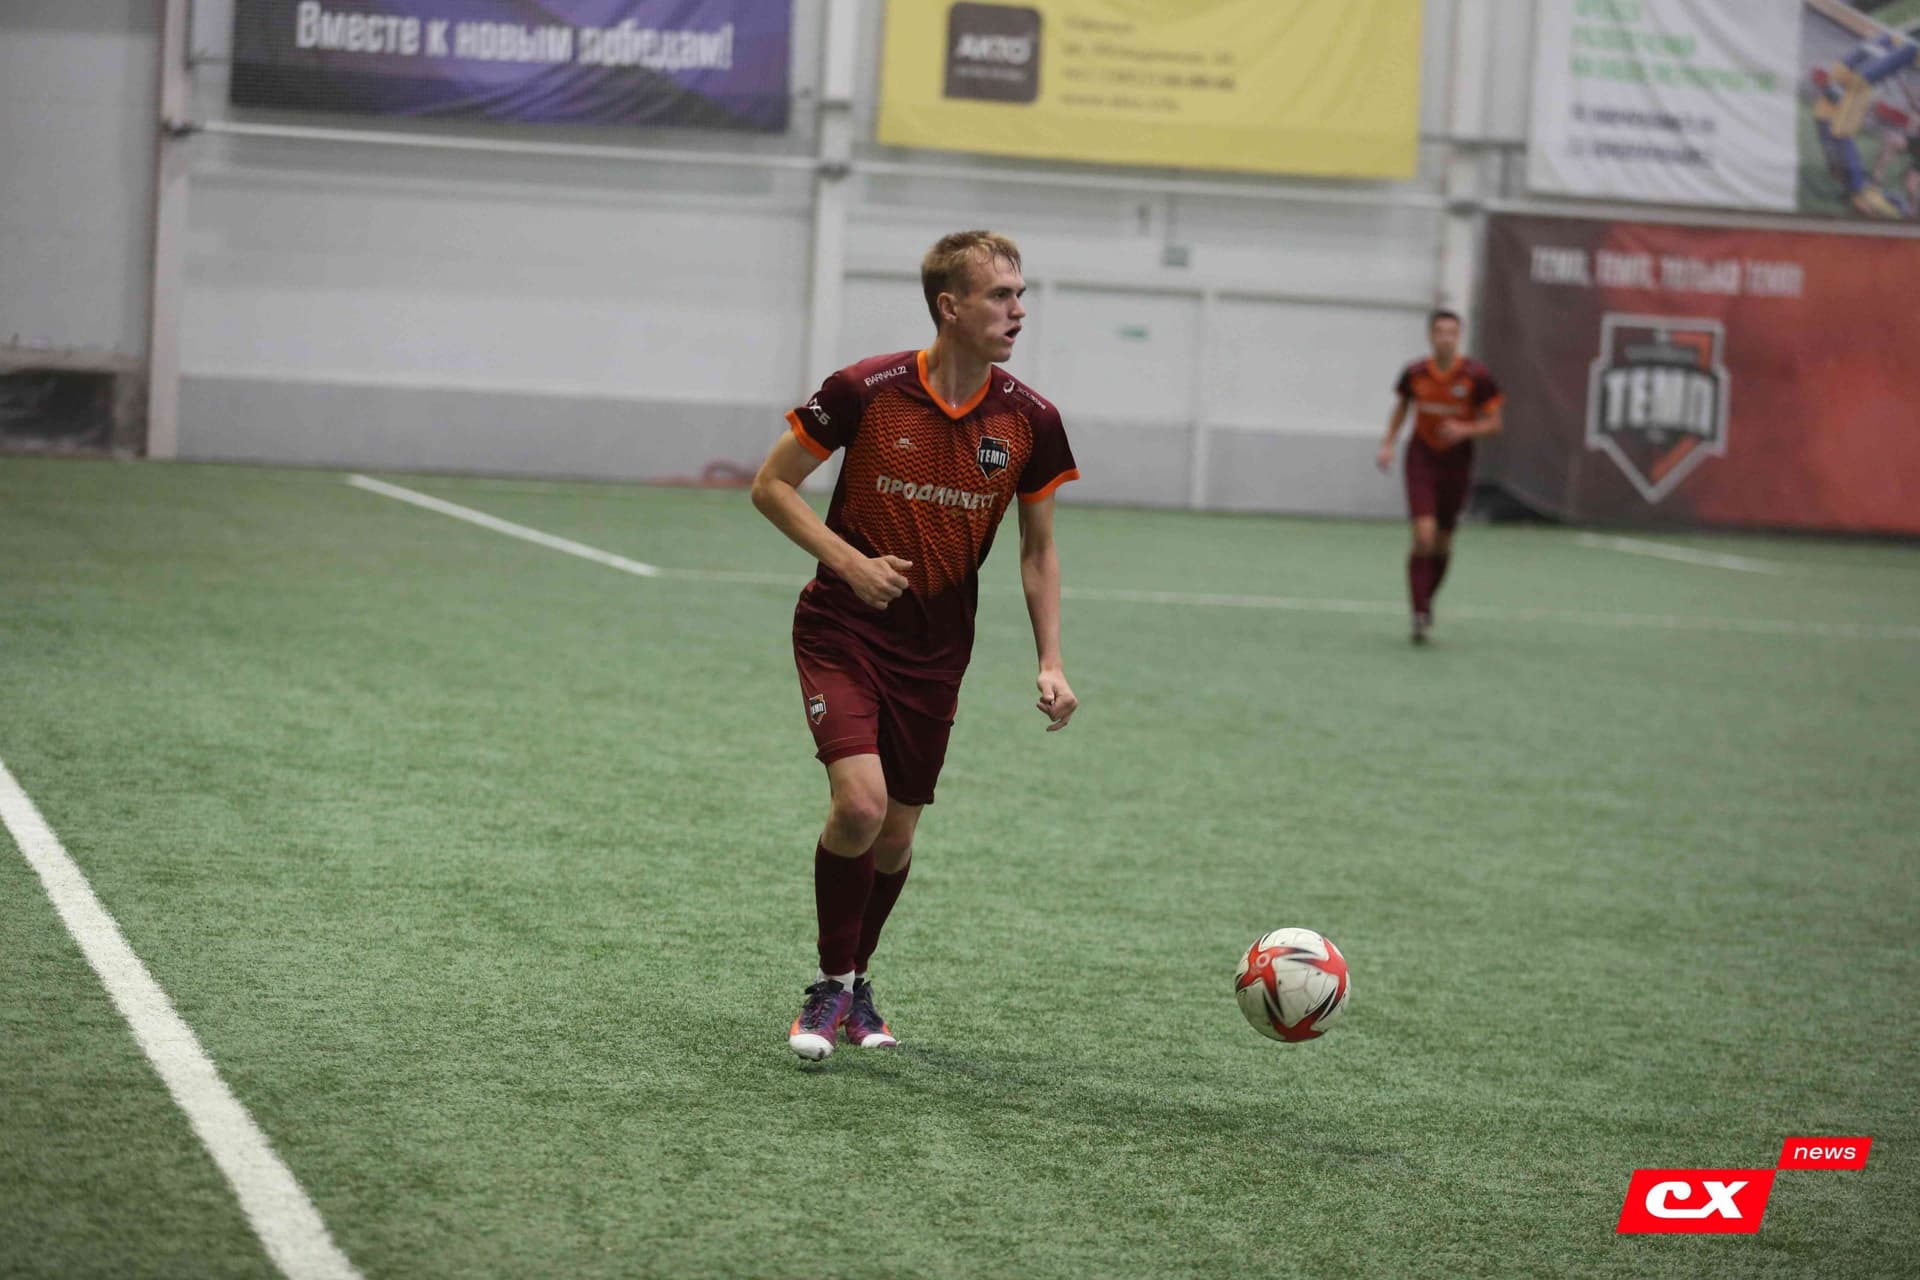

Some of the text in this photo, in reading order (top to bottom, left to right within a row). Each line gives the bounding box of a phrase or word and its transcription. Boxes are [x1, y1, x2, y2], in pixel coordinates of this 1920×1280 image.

[296, 0, 420, 56] Вместе
[426, 19, 449, 57] к
[454, 21, 573, 63] новым
[1604, 365, 1715, 436] ТЕМП
[979, 449, 1007, 467] ТЕМП
